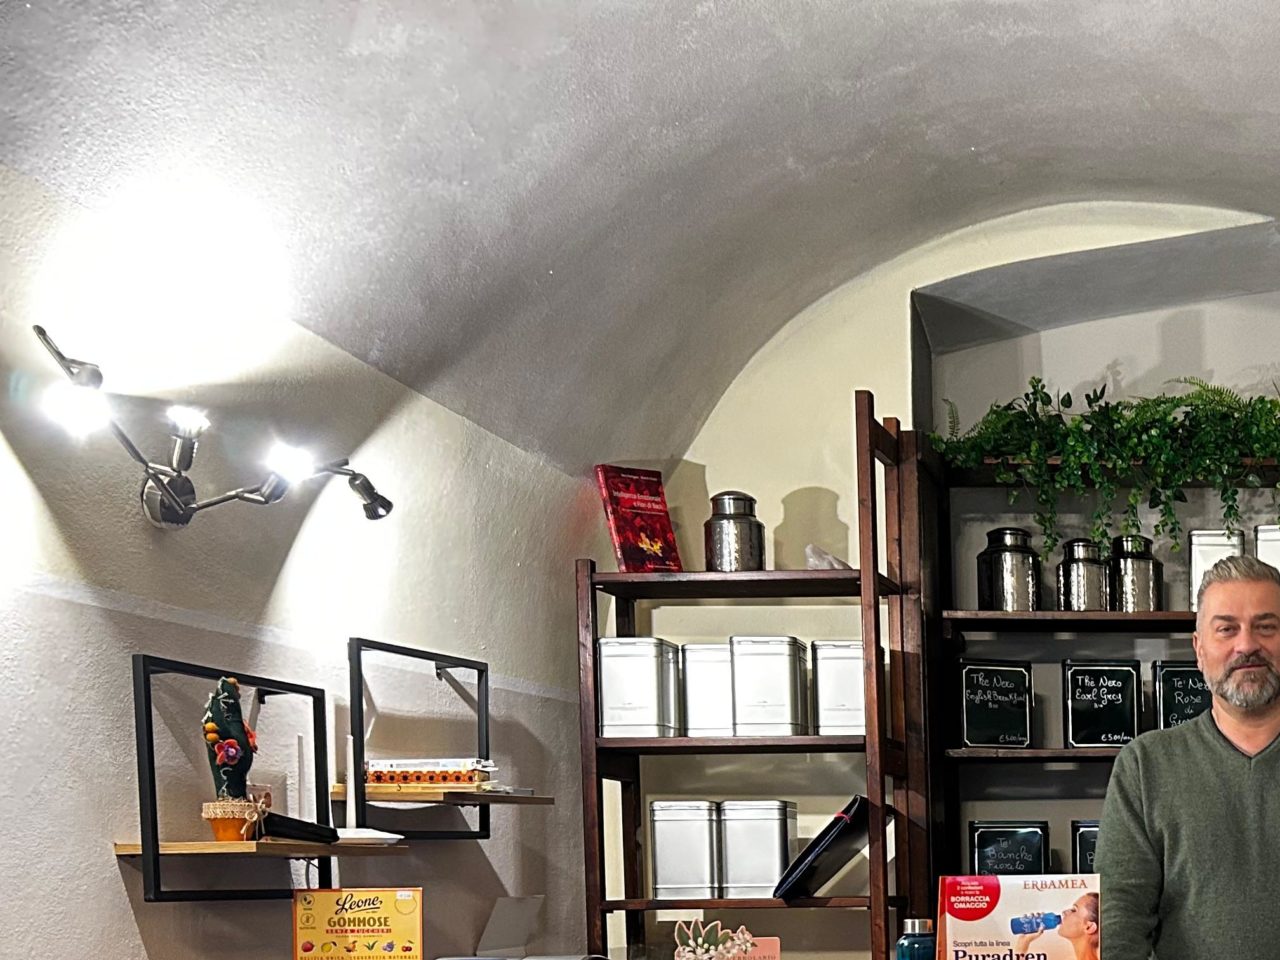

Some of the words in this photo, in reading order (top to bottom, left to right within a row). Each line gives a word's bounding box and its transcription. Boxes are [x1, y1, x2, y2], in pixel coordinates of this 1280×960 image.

[1099, 675, 1122, 687] Nero
[1075, 688, 1098, 700] Earl
[1100, 689, 1123, 705] Grey
[1023, 879, 1089, 892] ERBAMEA
[334, 893, 383, 915] Leone
[327, 916, 390, 928] GOMMOSE
[953, 940, 974, 949] Scopri
